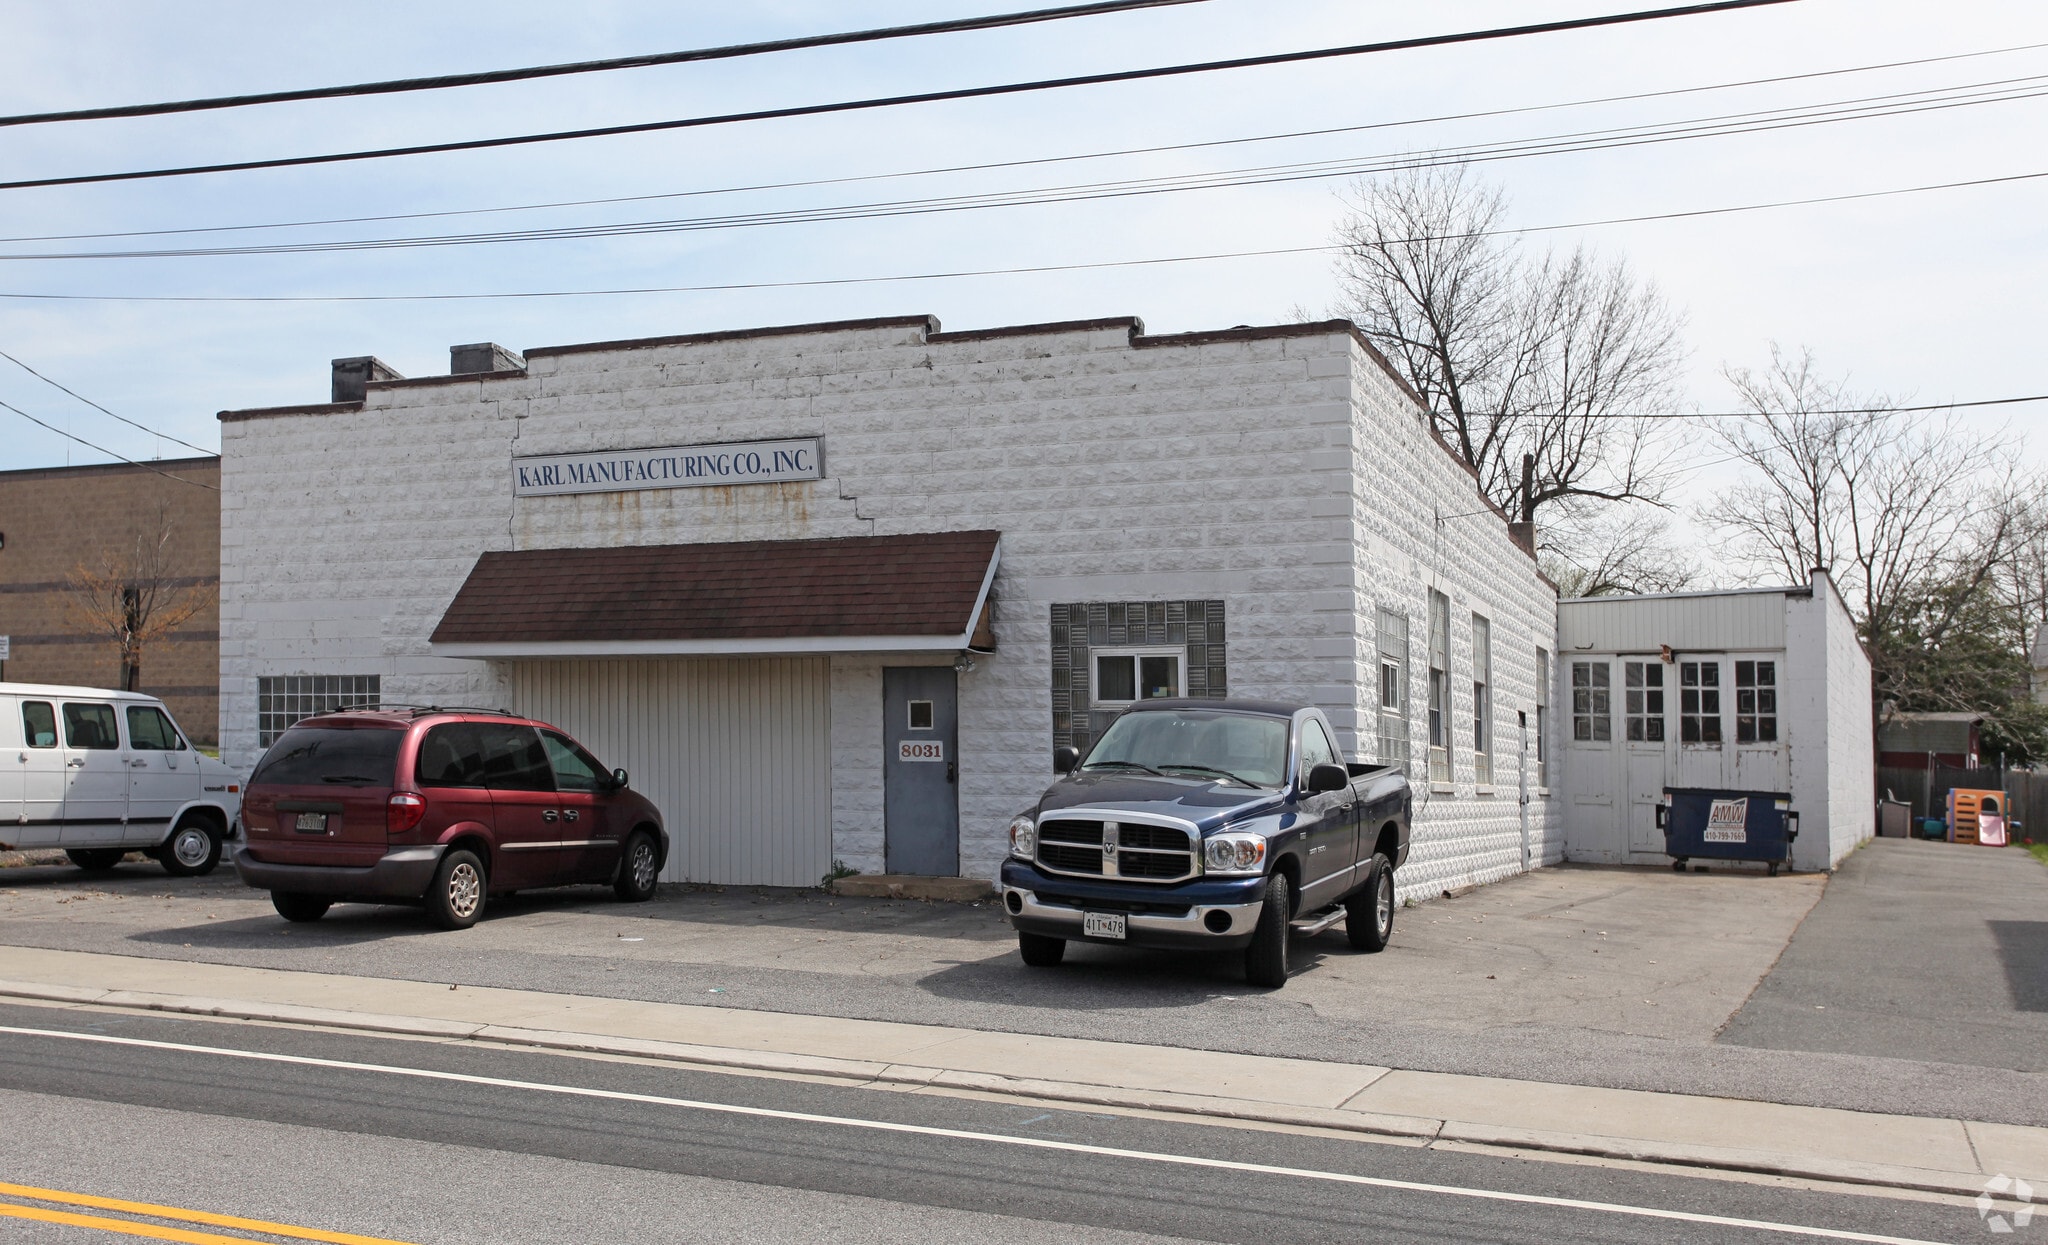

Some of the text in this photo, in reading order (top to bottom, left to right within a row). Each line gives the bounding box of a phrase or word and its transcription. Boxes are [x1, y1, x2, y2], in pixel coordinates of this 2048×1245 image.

[519, 449, 813, 487] KARL MANUFACTURING CO., INC.
[901, 744, 941, 757] 8031
[1711, 804, 1744, 822] AMW
[1107, 920, 1124, 934] 478
